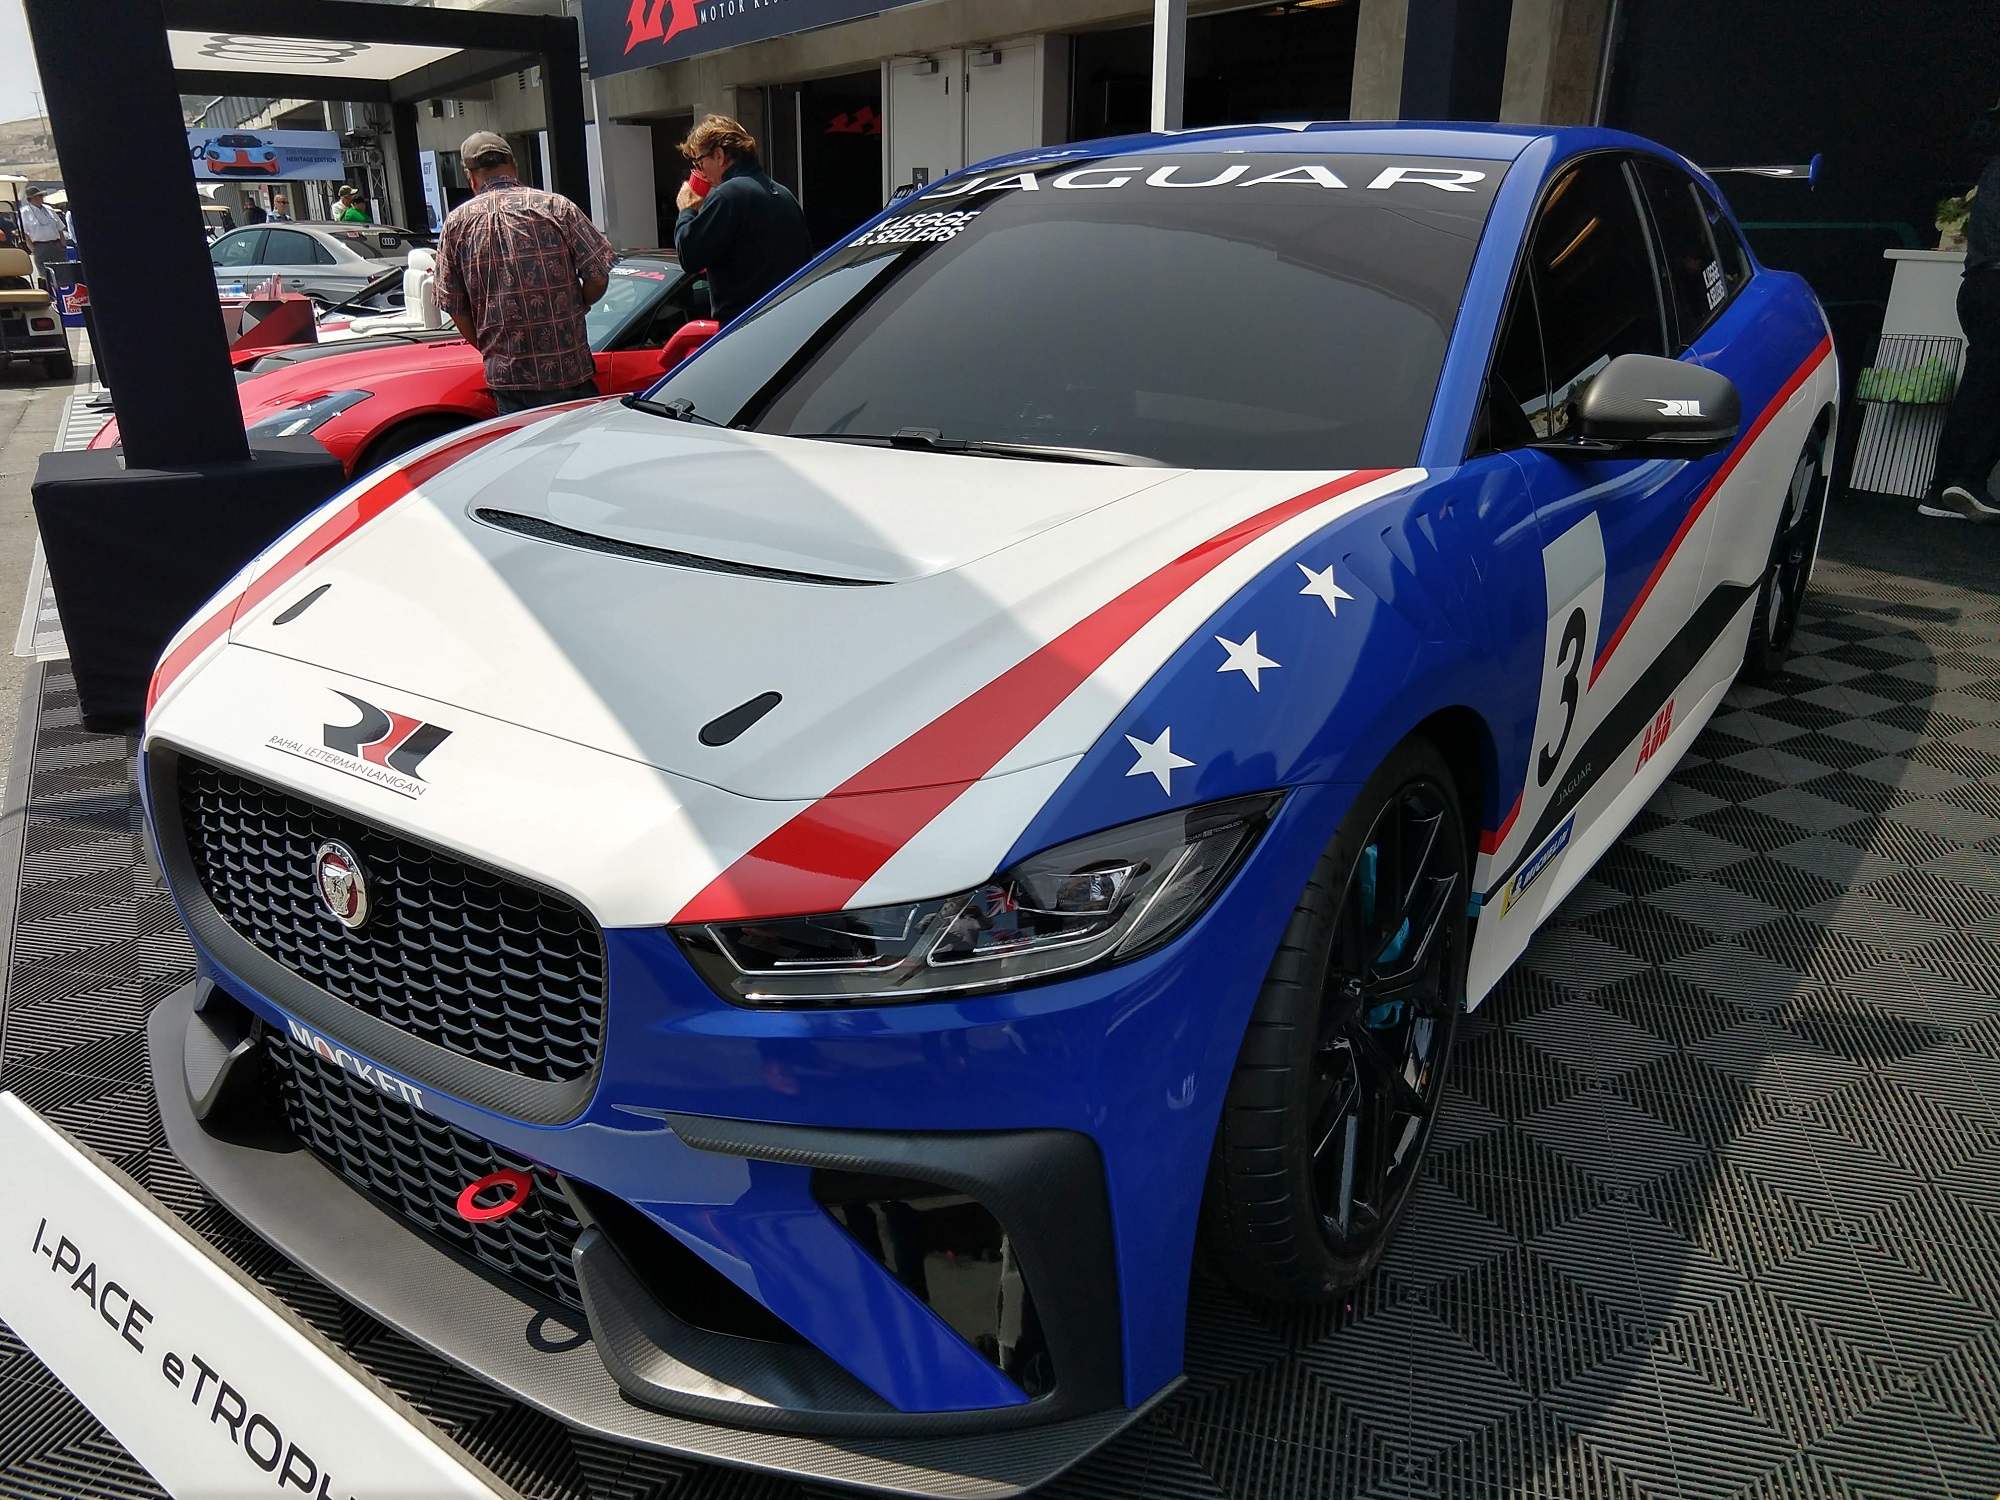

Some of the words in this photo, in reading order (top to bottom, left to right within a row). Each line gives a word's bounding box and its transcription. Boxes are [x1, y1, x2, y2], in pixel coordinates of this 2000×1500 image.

[700, 0, 745, 24] MOTOR
[918, 165, 1485, 200] JAGUAR
[1537, 606, 1587, 788] 3
[268, 735, 304, 752] RAHAL
[305, 745, 368, 776] LETTERMAN
[367, 768, 427, 796] LANIGAN
[1633, 698, 1676, 776] ABB
[1556, 762, 1593, 807] JAGUAR
[31, 1217, 155, 1354] I-PACE
